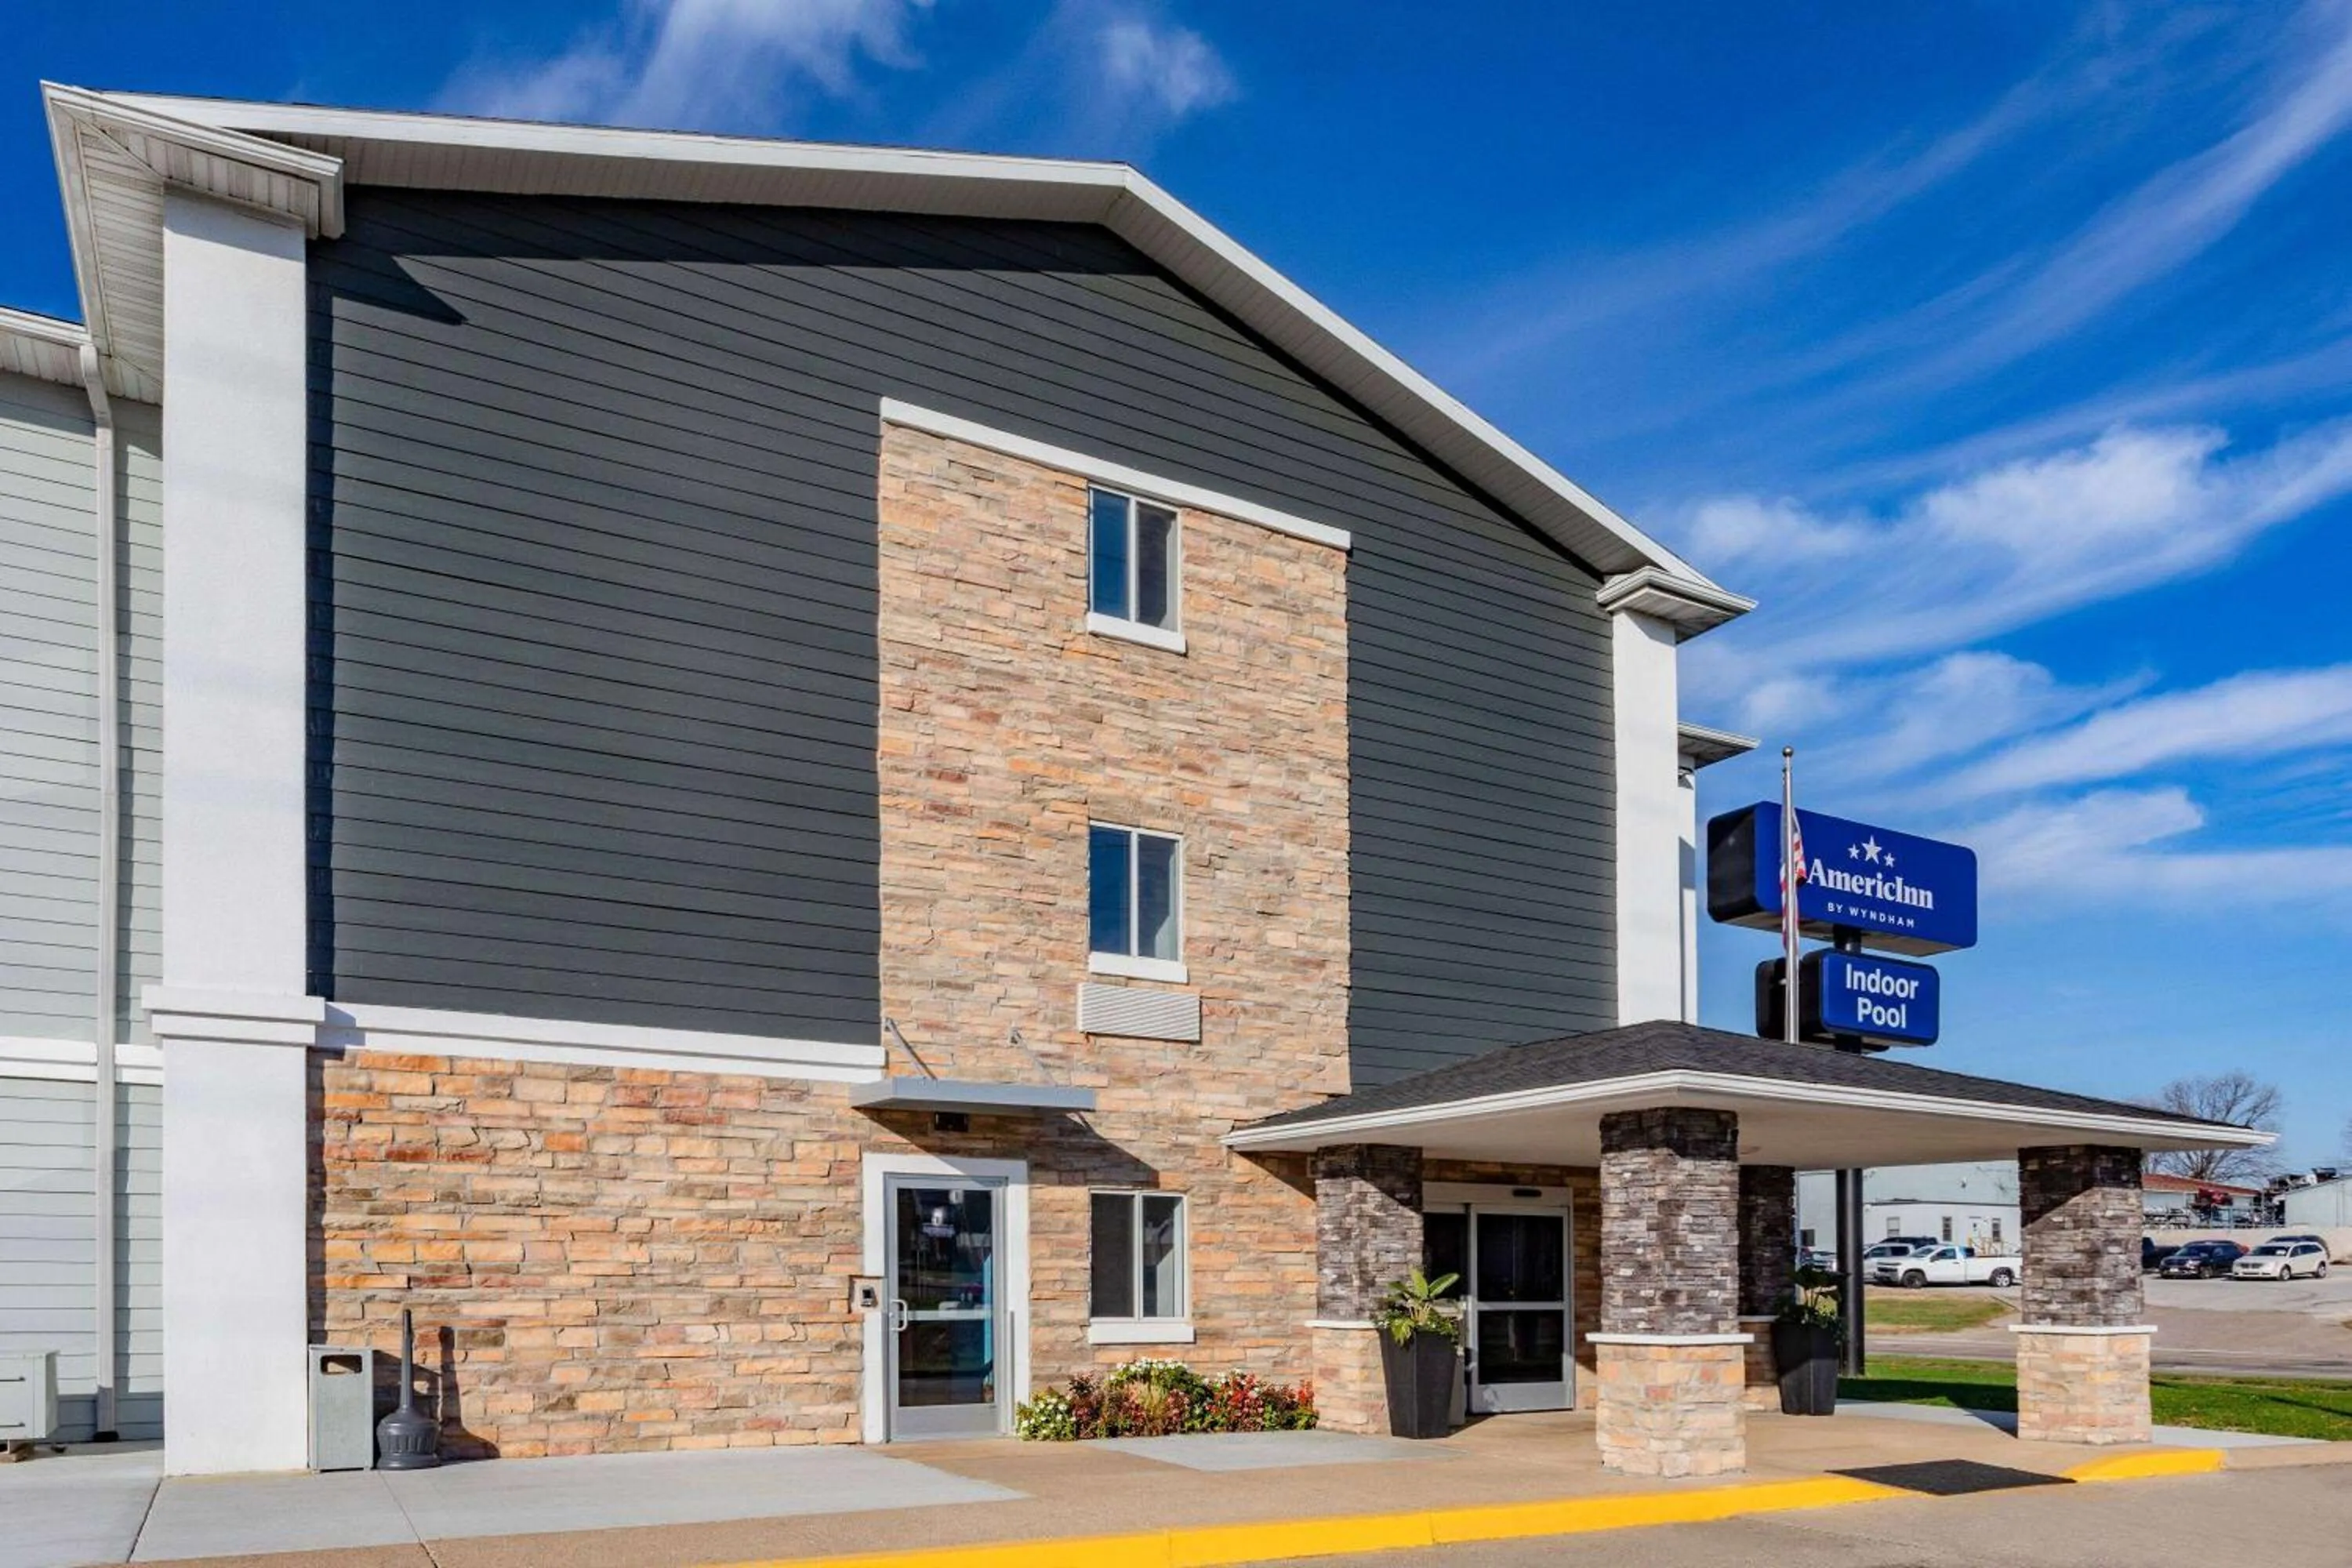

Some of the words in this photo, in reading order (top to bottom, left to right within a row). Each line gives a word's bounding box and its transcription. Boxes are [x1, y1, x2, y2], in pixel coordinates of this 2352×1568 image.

[1807, 859, 1934, 909] AmericInn
[1828, 902, 1842, 913] BY
[1849, 907, 1915, 928] WYNDHAM
[1846, 964, 1919, 1000] Indoor
[1857, 996, 1907, 1029] Pool
